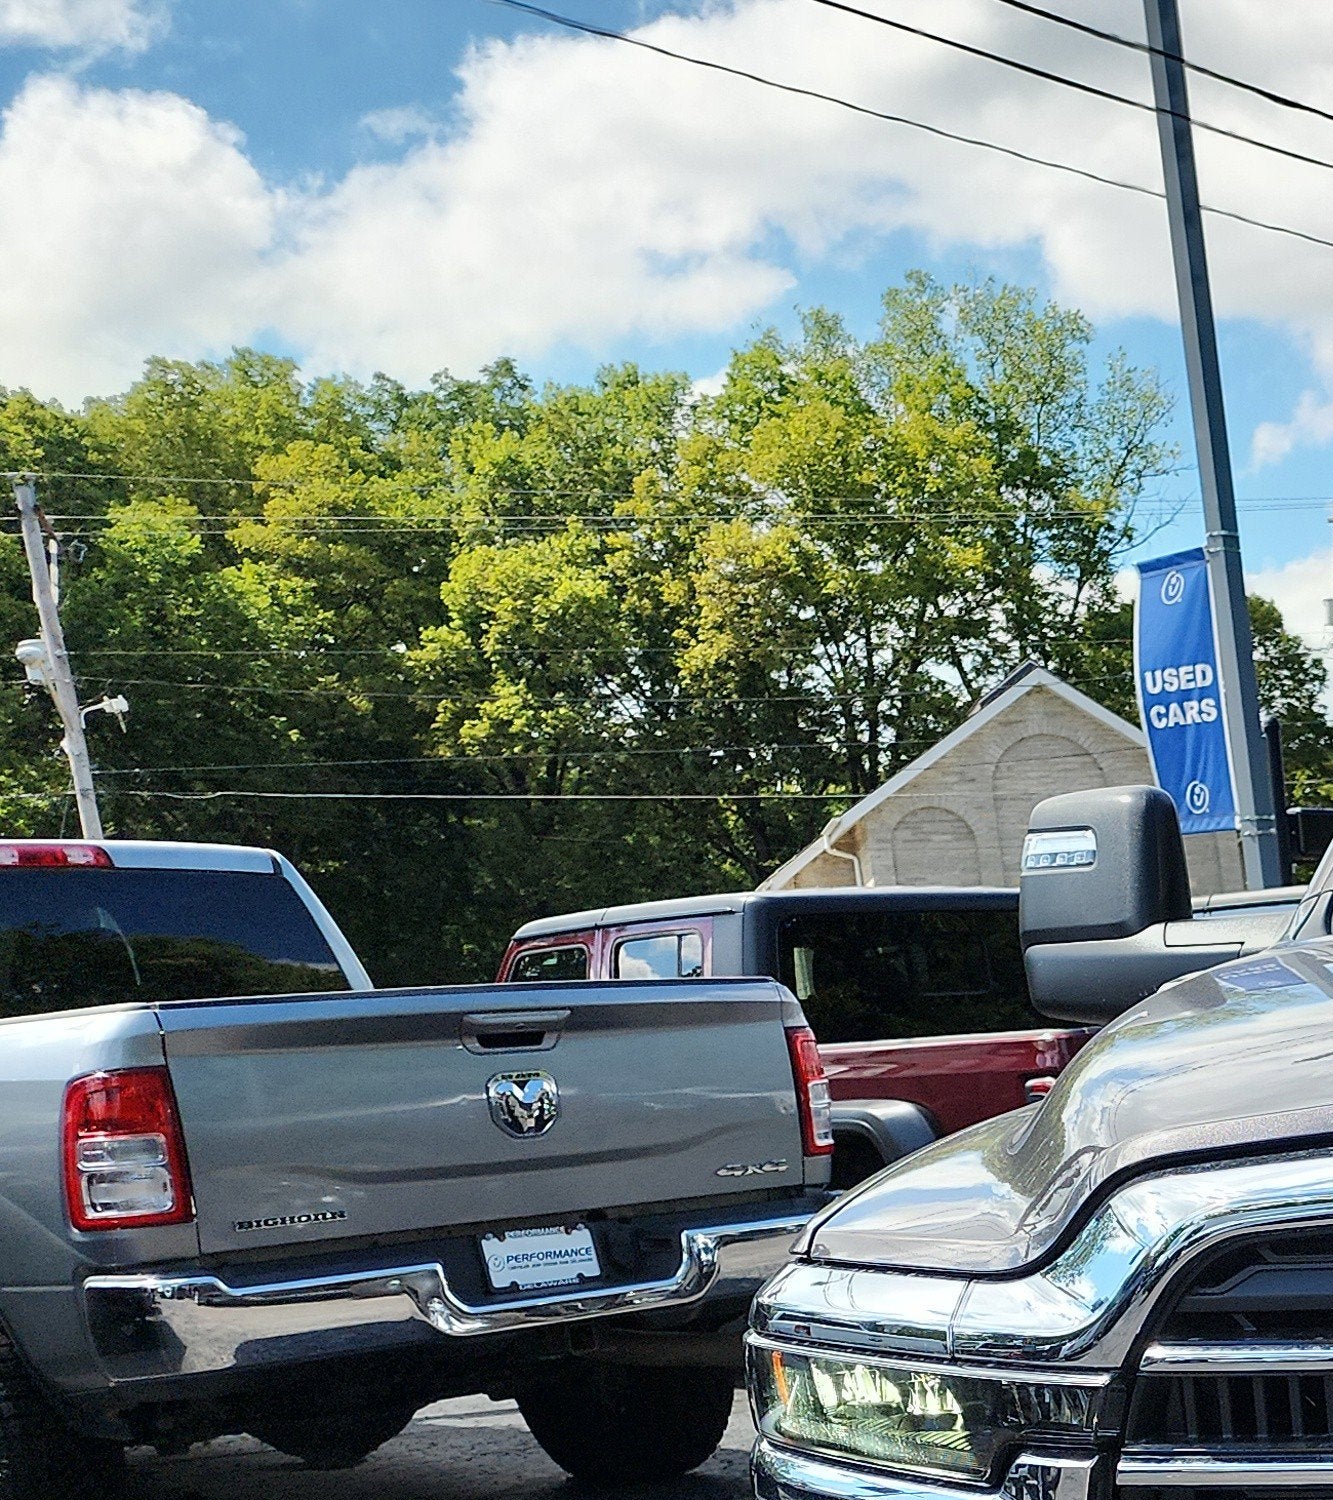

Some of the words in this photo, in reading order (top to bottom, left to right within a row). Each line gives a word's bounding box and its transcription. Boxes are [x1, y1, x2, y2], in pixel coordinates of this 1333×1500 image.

[1144, 663, 1214, 695] USED
[1150, 698, 1218, 730] CARS
[506, 1246, 593, 1265] PERFORMANCE
